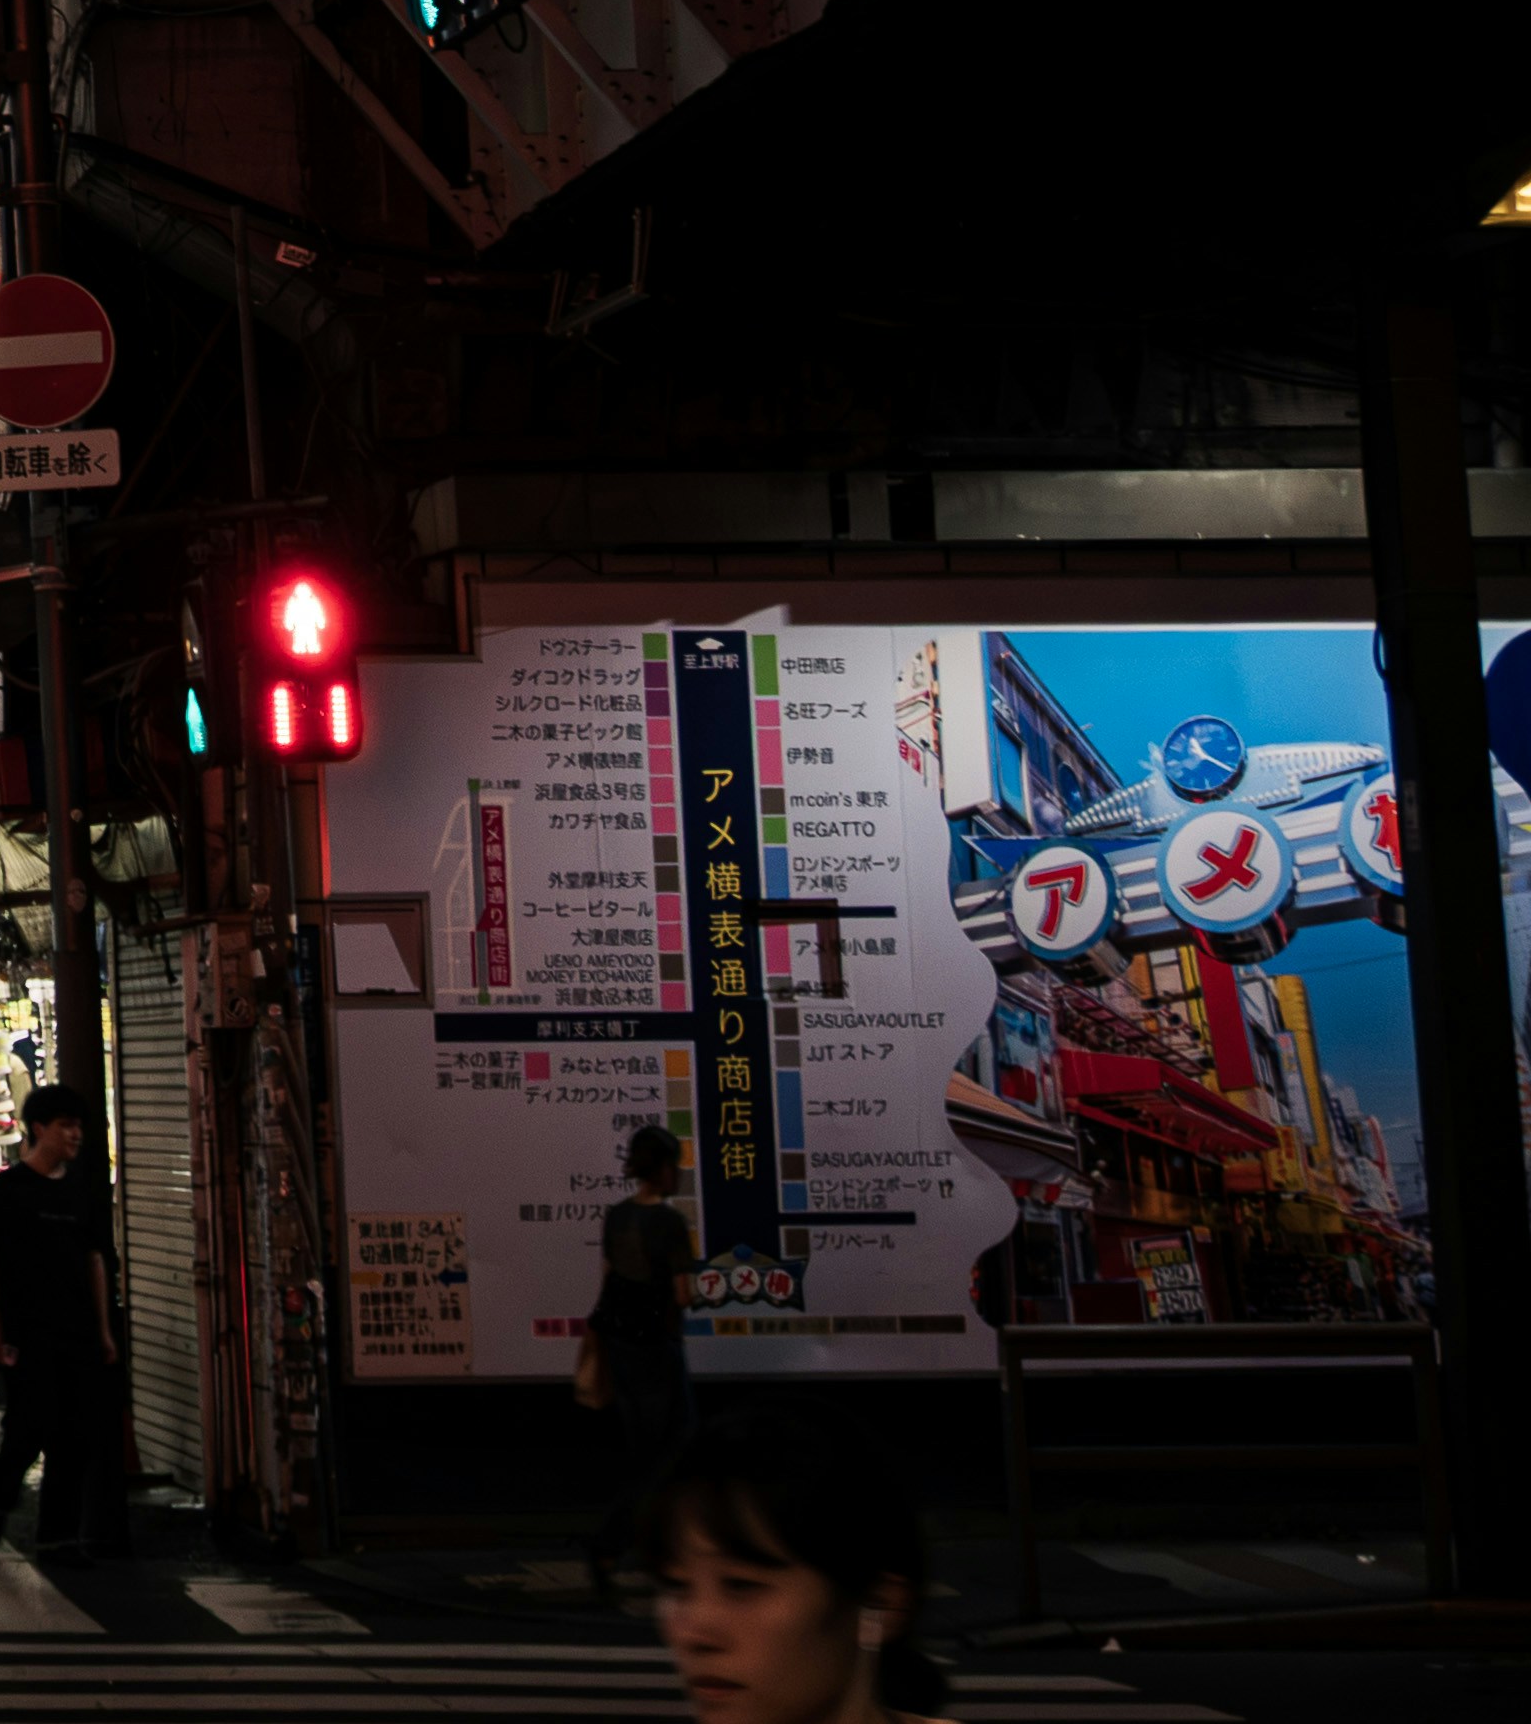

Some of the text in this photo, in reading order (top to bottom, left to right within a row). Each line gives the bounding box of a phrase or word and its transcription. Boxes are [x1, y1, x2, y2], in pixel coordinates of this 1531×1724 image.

[781, 657, 846, 675] 中田商店
[792, 821, 876, 838] REGATTO
[793, 855, 901, 874] ロンドンスポーツ
[544, 953, 655, 968] UENO AMEYOKO
[526, 969, 654, 984] MONEY EXCHANGE
[701, 768, 757, 1182] アメ横表通り商店街
[803, 1012, 946, 1029] SASUGAYAOUTLET
[524, 1086, 662, 1105] ディスカウント二木
[806, 1098, 888, 1117] 二木ゴルフ
[810, 1151, 953, 1168] SASUGAYAOUTLET
[569, 1174, 639, 1192] ドンキホ
[518, 1203, 611, 1223] 銀座パリス
